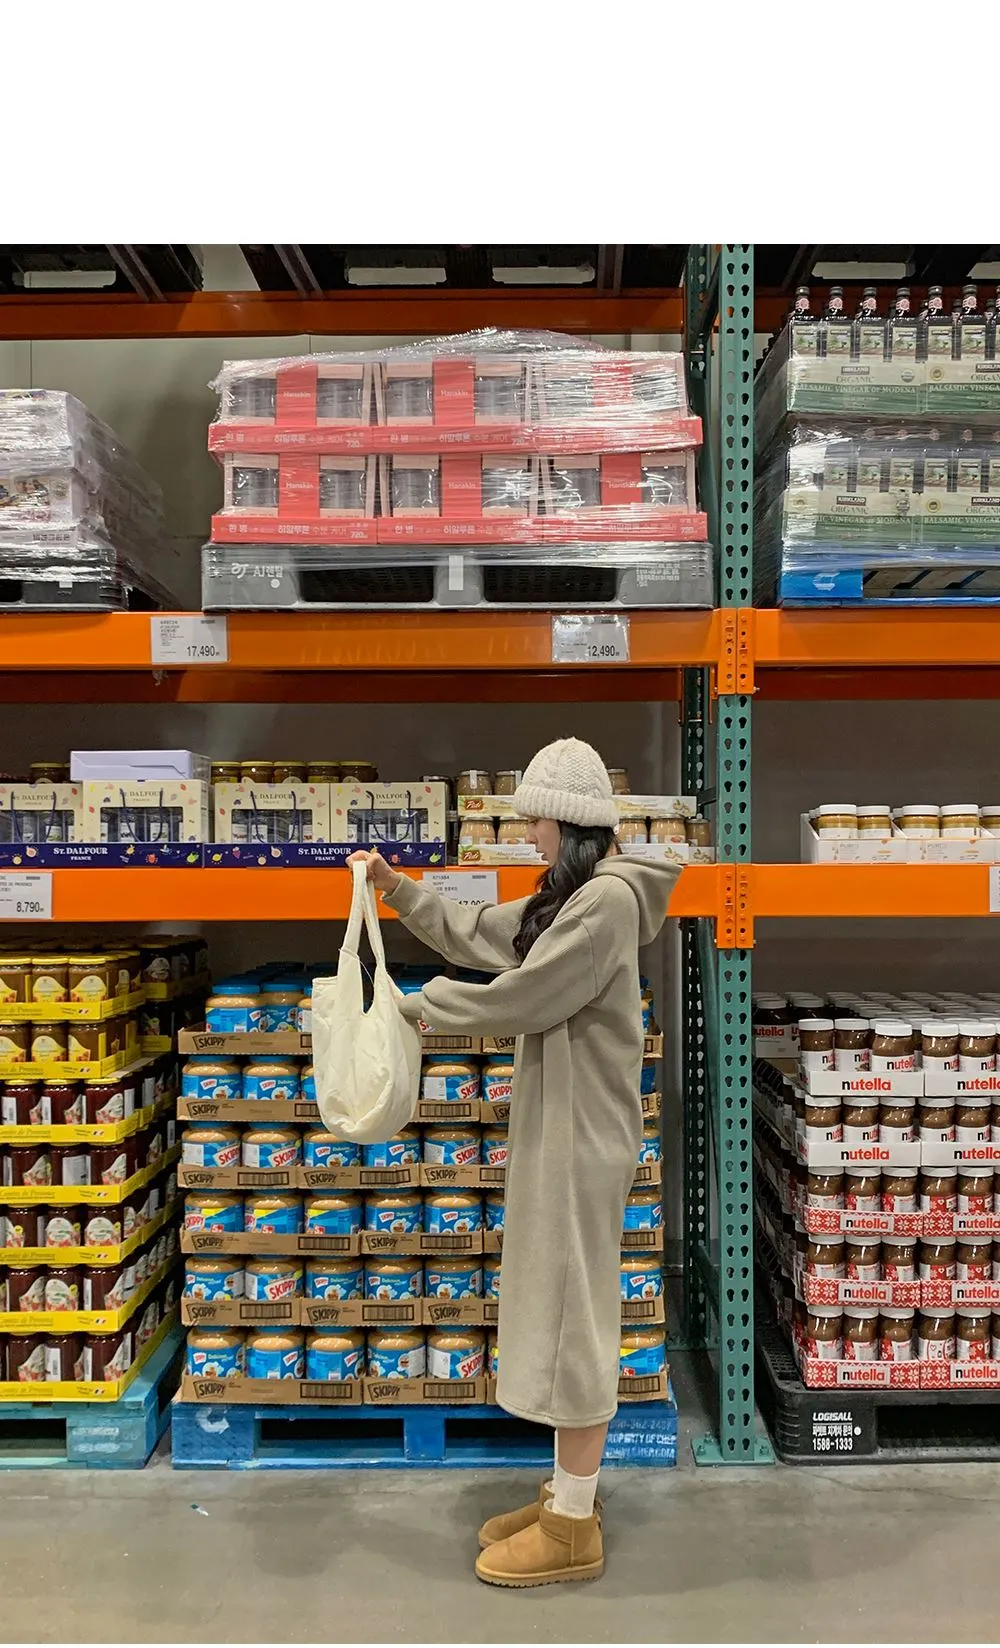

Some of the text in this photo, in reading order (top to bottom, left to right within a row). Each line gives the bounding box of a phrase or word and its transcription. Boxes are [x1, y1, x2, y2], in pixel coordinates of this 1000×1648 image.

[66, 847, 108, 855] DALFOUR
[311, 847, 351, 855] DALFOUR
[199, 1037, 226, 1048] SKIPPY
[842, 1078, 892, 1090] nutella
[192, 1104, 220, 1115] SKIPPY
[841, 1148, 890, 1161] nutella
[430, 1169, 457, 1181] SKIPPY
[846, 1217, 889, 1230] nutella
[371, 1237, 398, 1249] SKIPPY
[269, 1279, 296, 1299] SKIPPY
[844, 1288, 887, 1300] nutella
[957, 1287, 1000, 1299] nutella
[192, 1306, 217, 1318] SKIPPY
[313, 1308, 340, 1321] SKIPPY
[433, 1308, 461, 1320] SKIPPY
[842, 1369, 885, 1381] nutella
[955, 1368, 998, 1379] nutella
[199, 1383, 226, 1396] SKIPPY
[373, 1385, 401, 1398] SKIPPY
[813, 1411, 853, 1421] LOGISALL
[812, 1437, 853, 1451] 1588-1333
